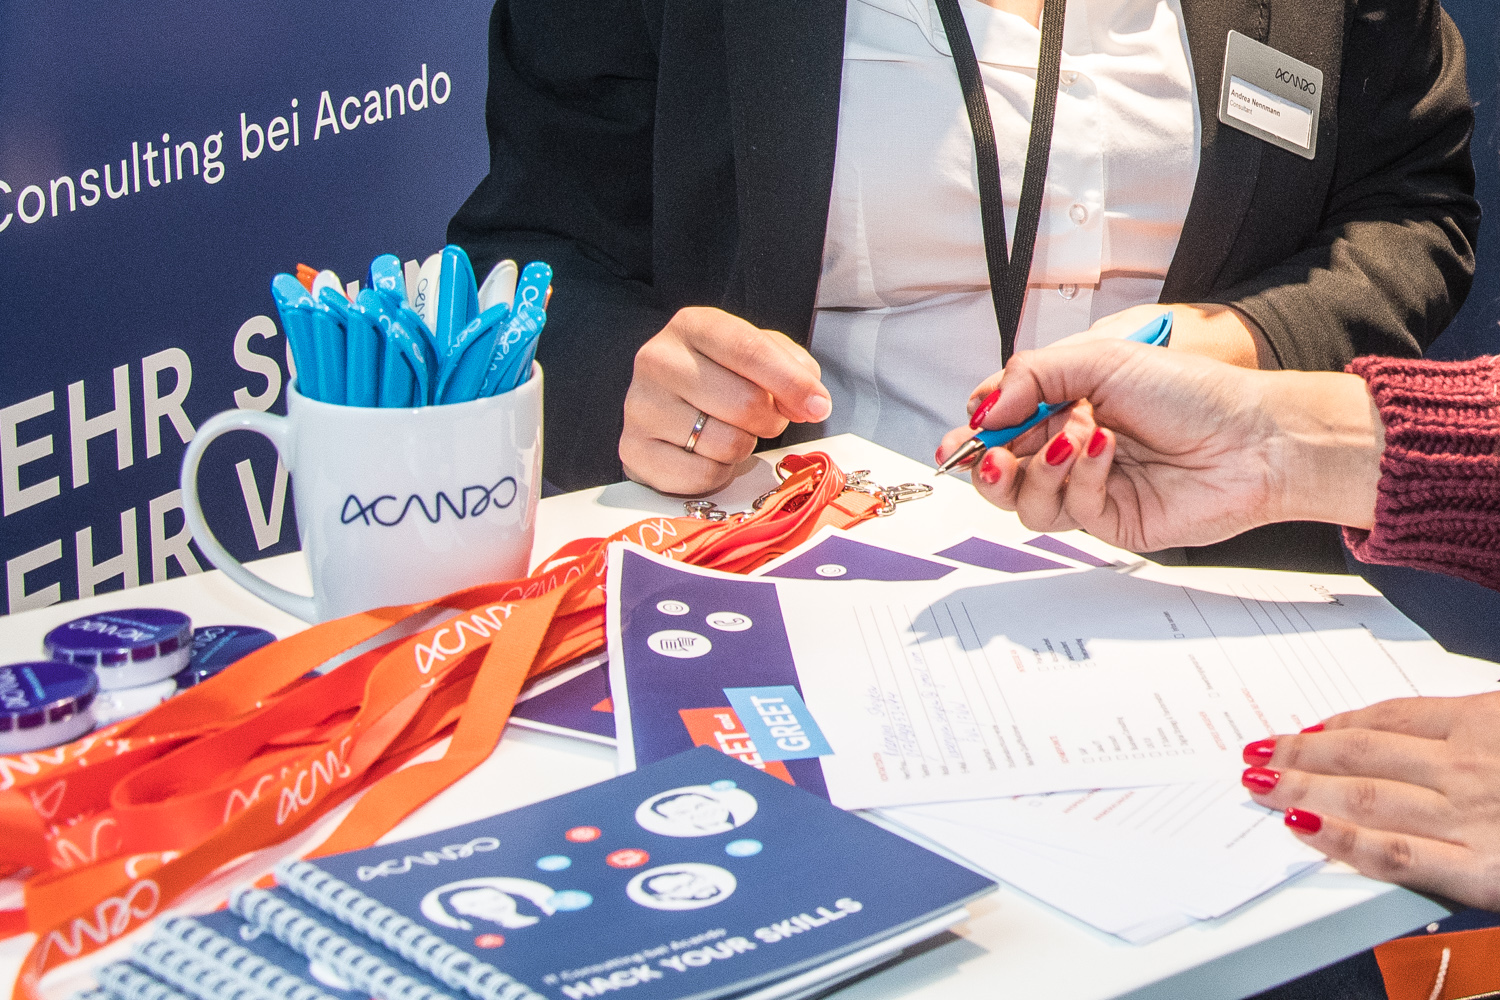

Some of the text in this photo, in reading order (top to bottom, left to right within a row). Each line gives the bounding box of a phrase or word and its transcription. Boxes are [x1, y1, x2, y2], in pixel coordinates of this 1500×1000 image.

[1275, 67, 1316, 95] ACANDO
[240, 98, 299, 161] bei
[314, 63, 451, 140] Acando
[341, 477, 517, 526] ACANDO
[751, 695, 811, 751] GREET
[714, 731, 766, 770] EET
[357, 837, 500, 881] ACANDO
[562, 898, 863, 1000] HACK YOUR SKILLS
